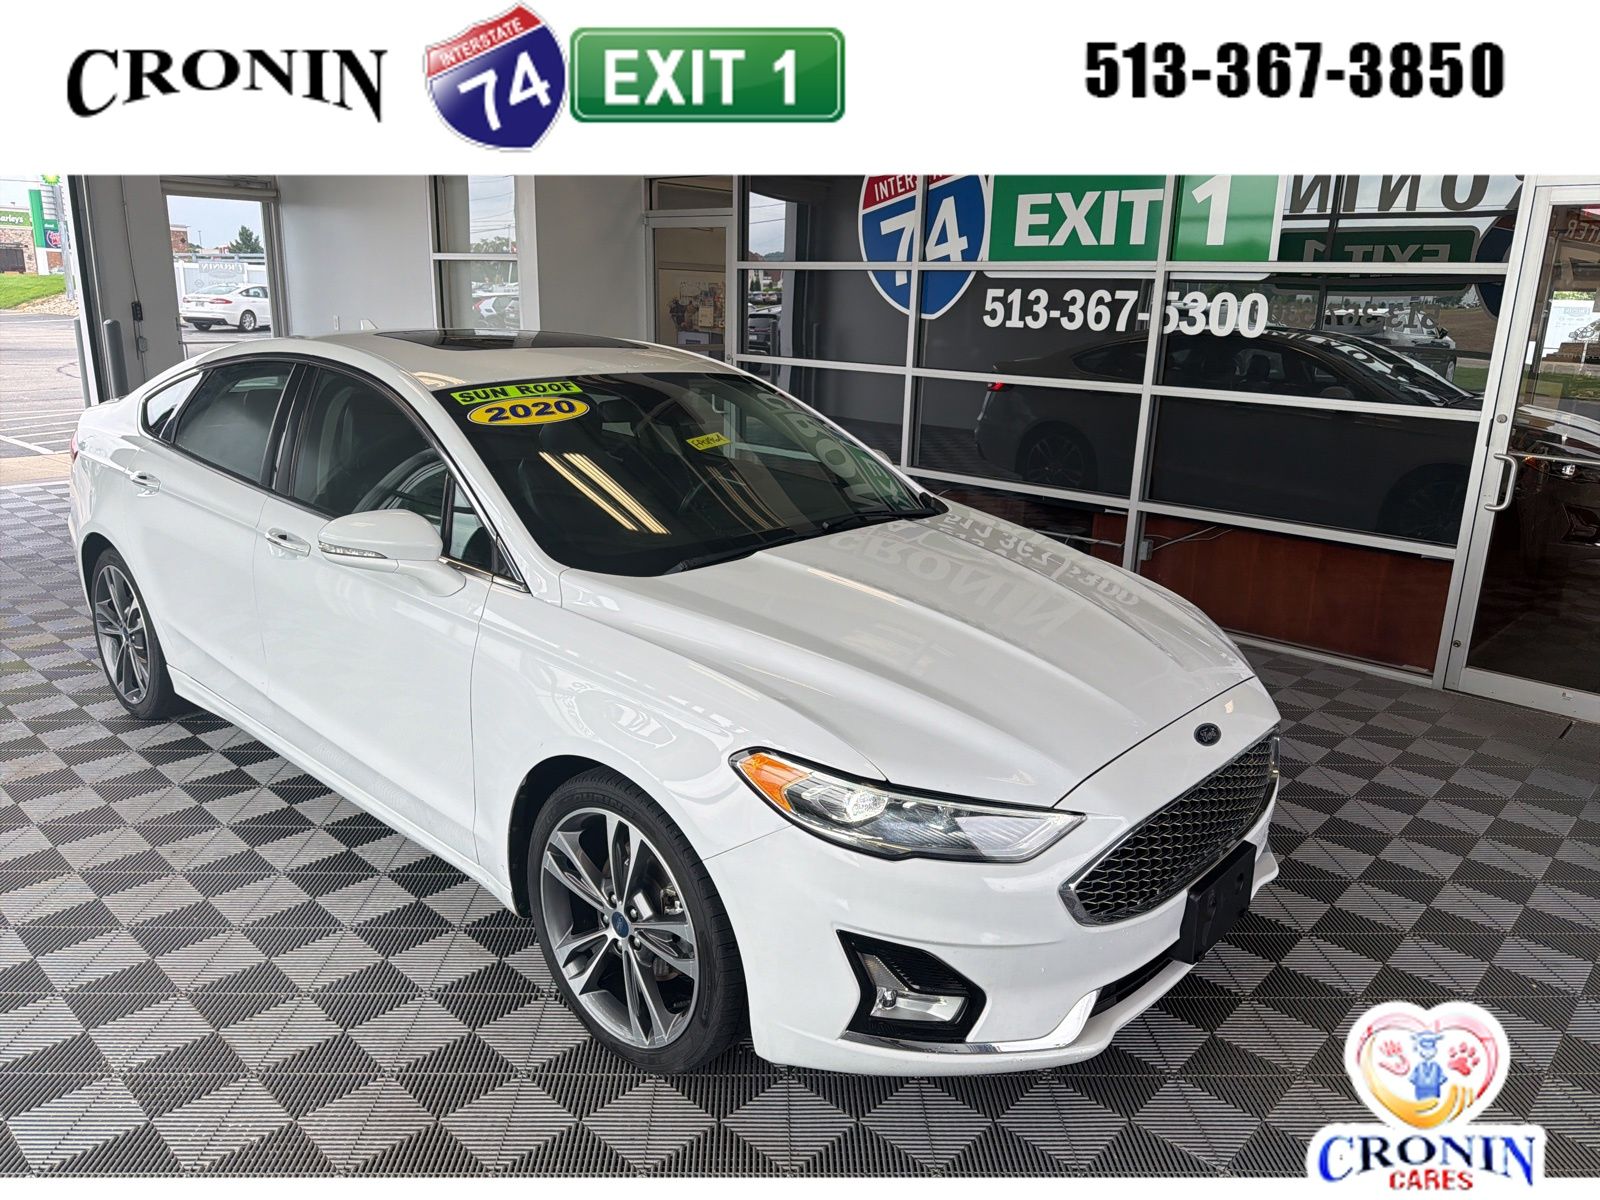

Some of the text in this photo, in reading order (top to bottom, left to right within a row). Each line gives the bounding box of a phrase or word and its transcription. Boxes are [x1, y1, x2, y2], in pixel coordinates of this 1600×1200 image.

[1013, 174, 1232, 247] EXIT 1
[879, 195, 969, 287] 74
[982, 288, 1269, 339] 513-367-5300
[458, 381, 574, 403] SUN ROOF
[484, 400, 576, 423] 2020
